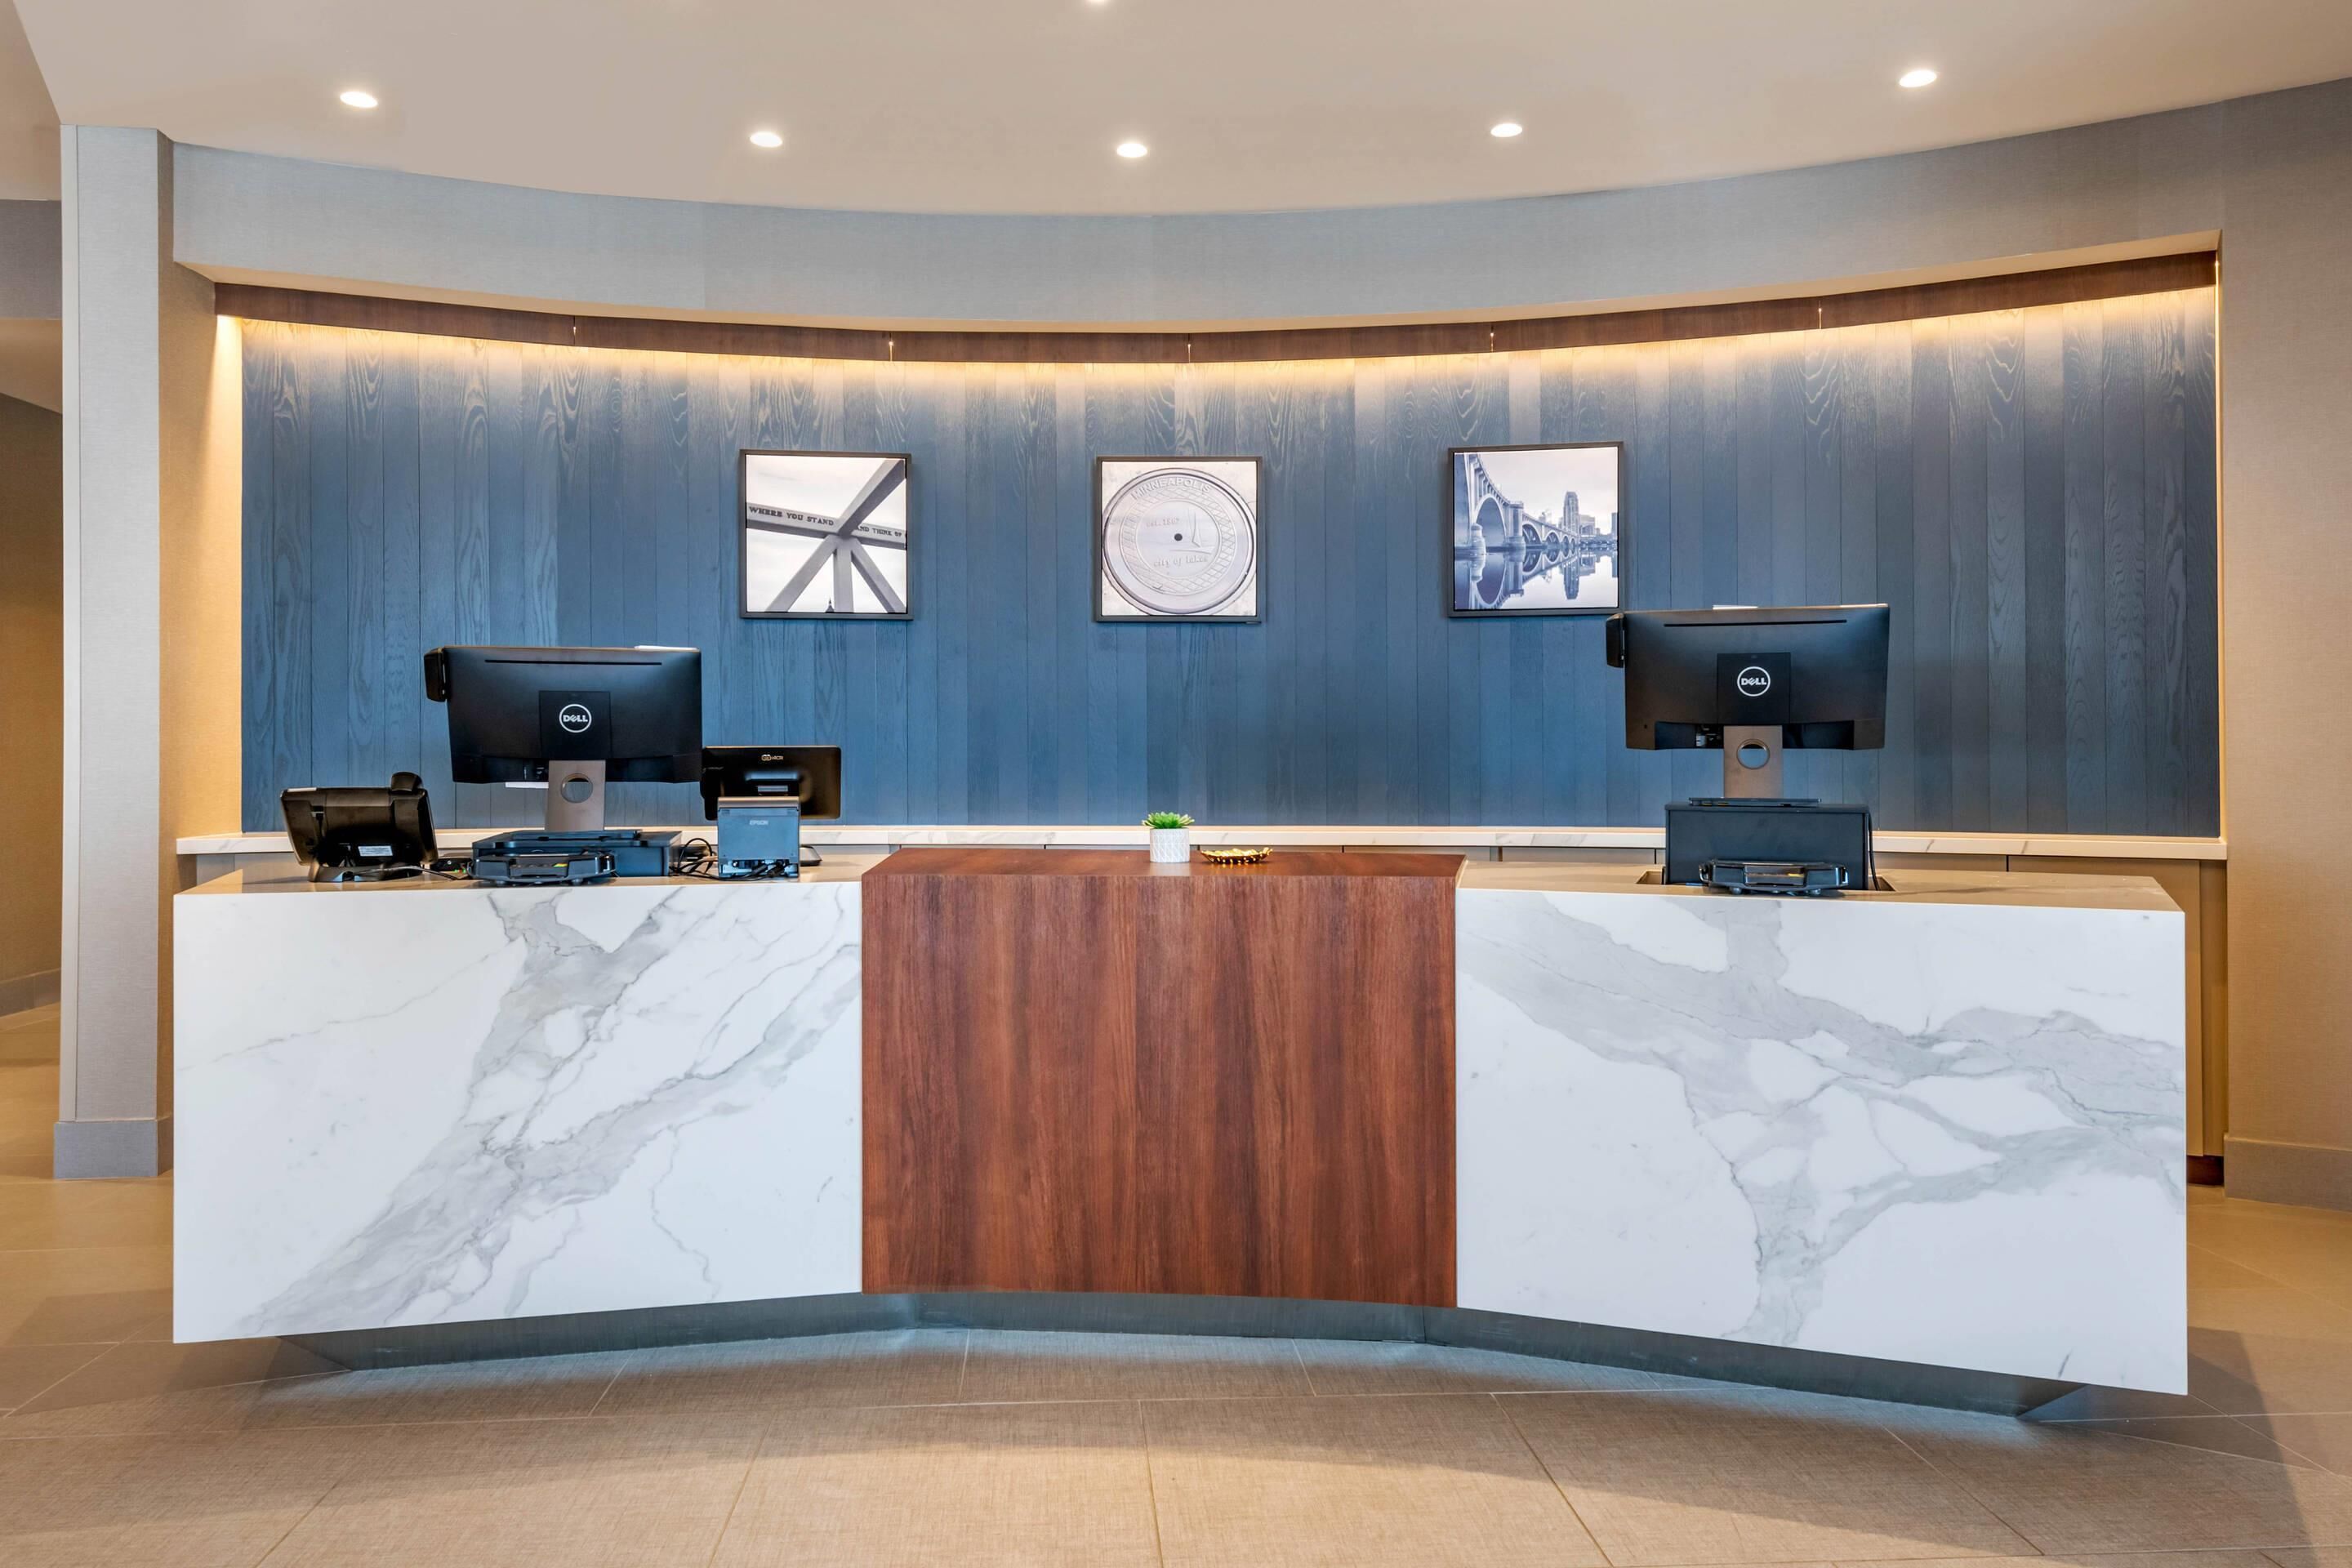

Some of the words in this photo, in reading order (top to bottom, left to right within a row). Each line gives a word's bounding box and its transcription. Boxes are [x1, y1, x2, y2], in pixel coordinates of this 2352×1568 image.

[1130, 477, 1210, 500] MINNEAPOLIS
[749, 506, 782, 517] WHERE
[786, 512, 804, 520] YOU
[807, 516, 835, 526] STAND
[1740, 677, 1767, 686] DELL
[563, 714, 588, 723] DELL
